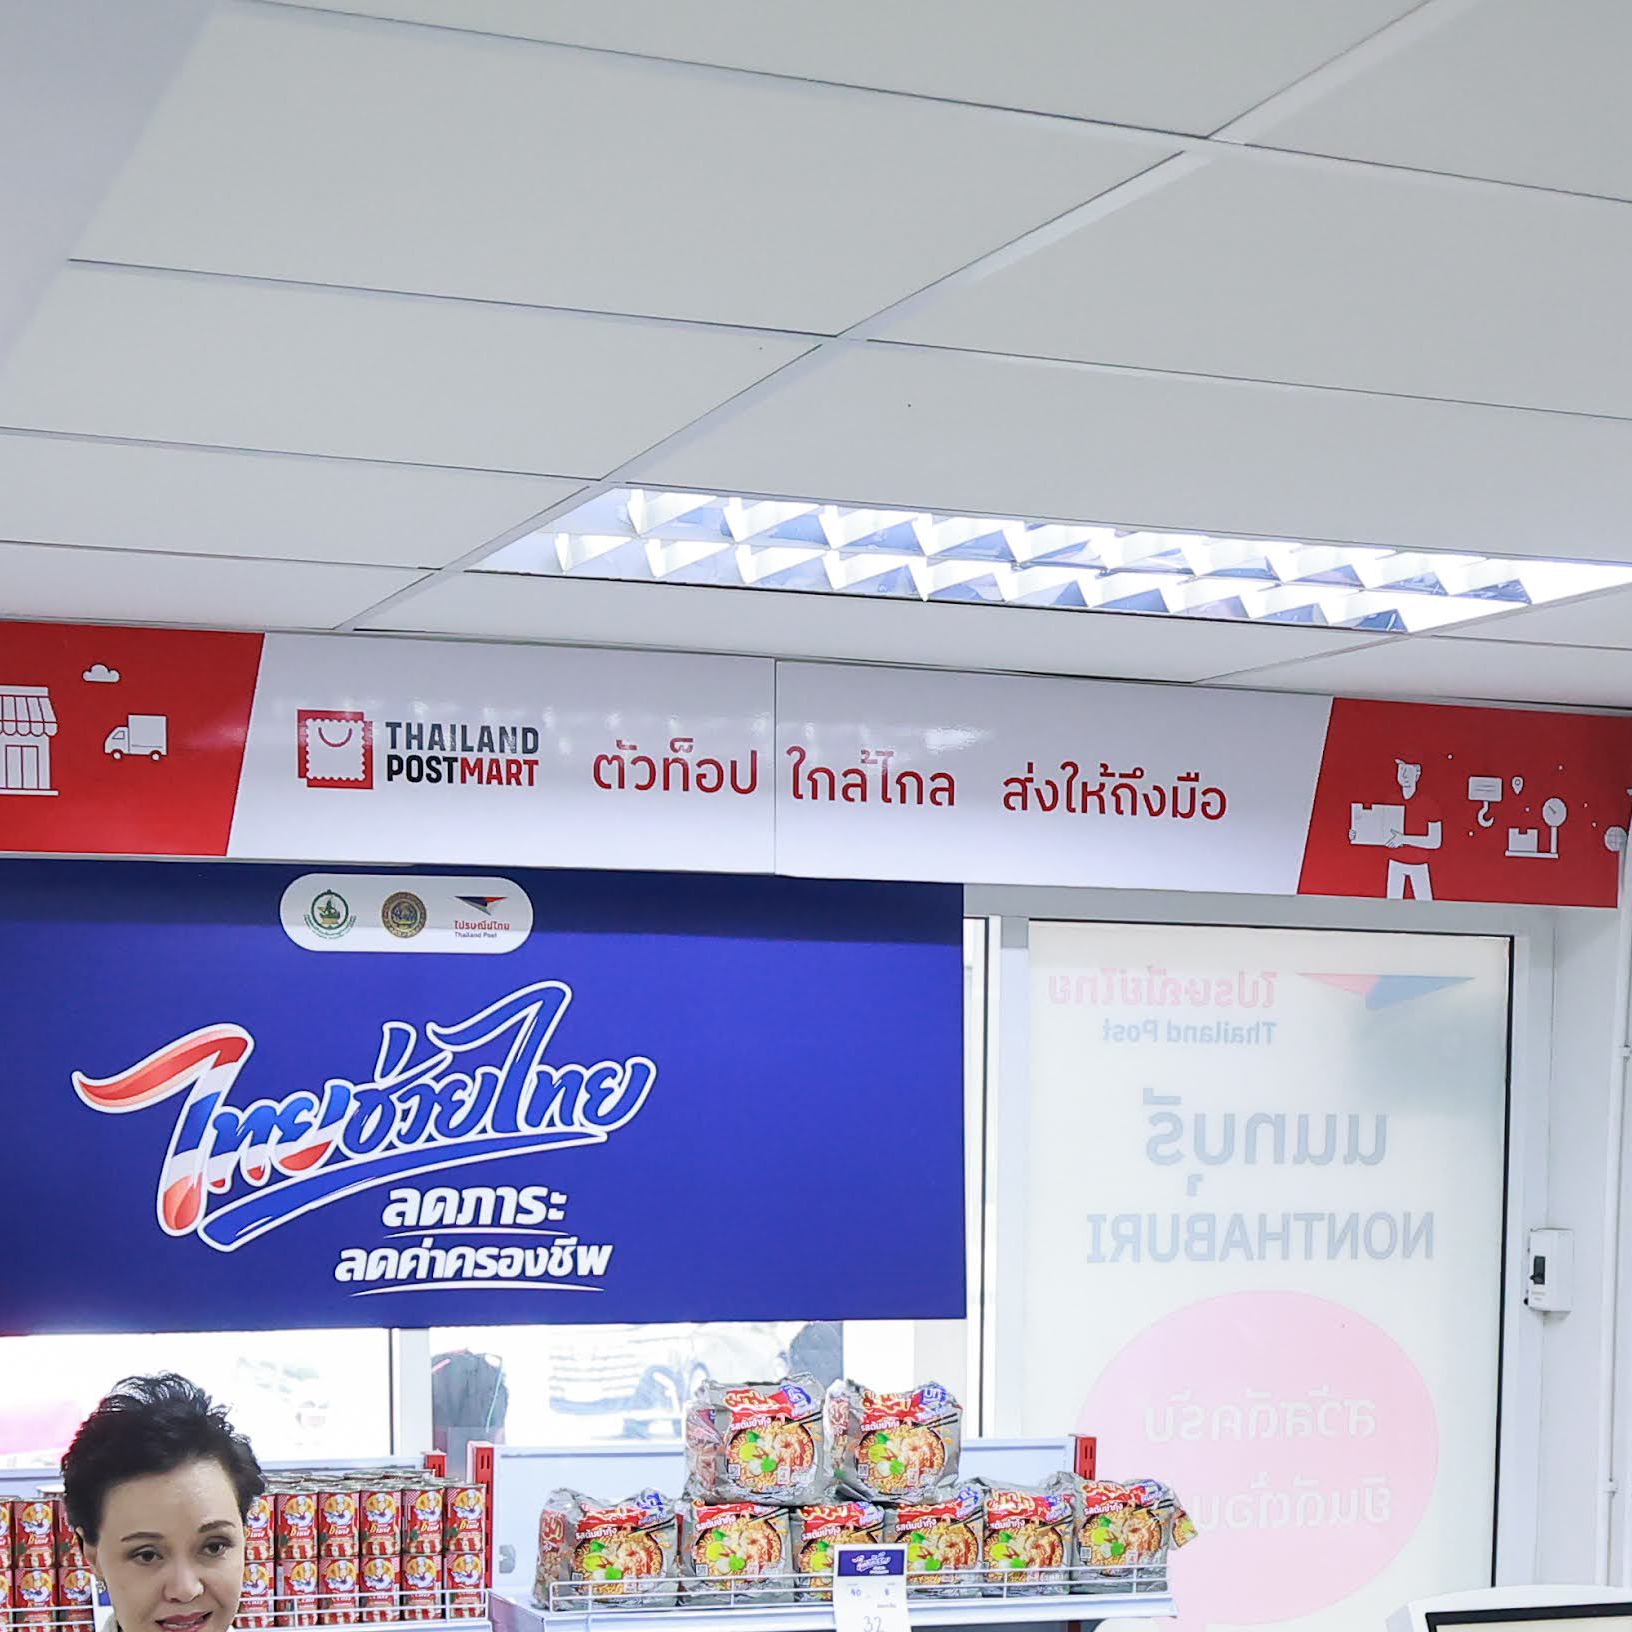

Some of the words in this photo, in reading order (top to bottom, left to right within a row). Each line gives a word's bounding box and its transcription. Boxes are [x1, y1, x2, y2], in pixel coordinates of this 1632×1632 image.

[385, 721, 540, 756] THAILAND
[385, 754, 539, 787] POSTMART
[592, 736, 759, 797] ตัวท็อป
[785, 746, 957, 808] ใกล้ไกล
[1001, 760, 1228, 822] ส่งให้ถึงมือ
[71, 980, 658, 1237] ไทยช่วยไทย
[381, 1184, 567, 1230] ลดภาระ
[334, 1237, 614, 1284] ลดค่าครองชีพ
